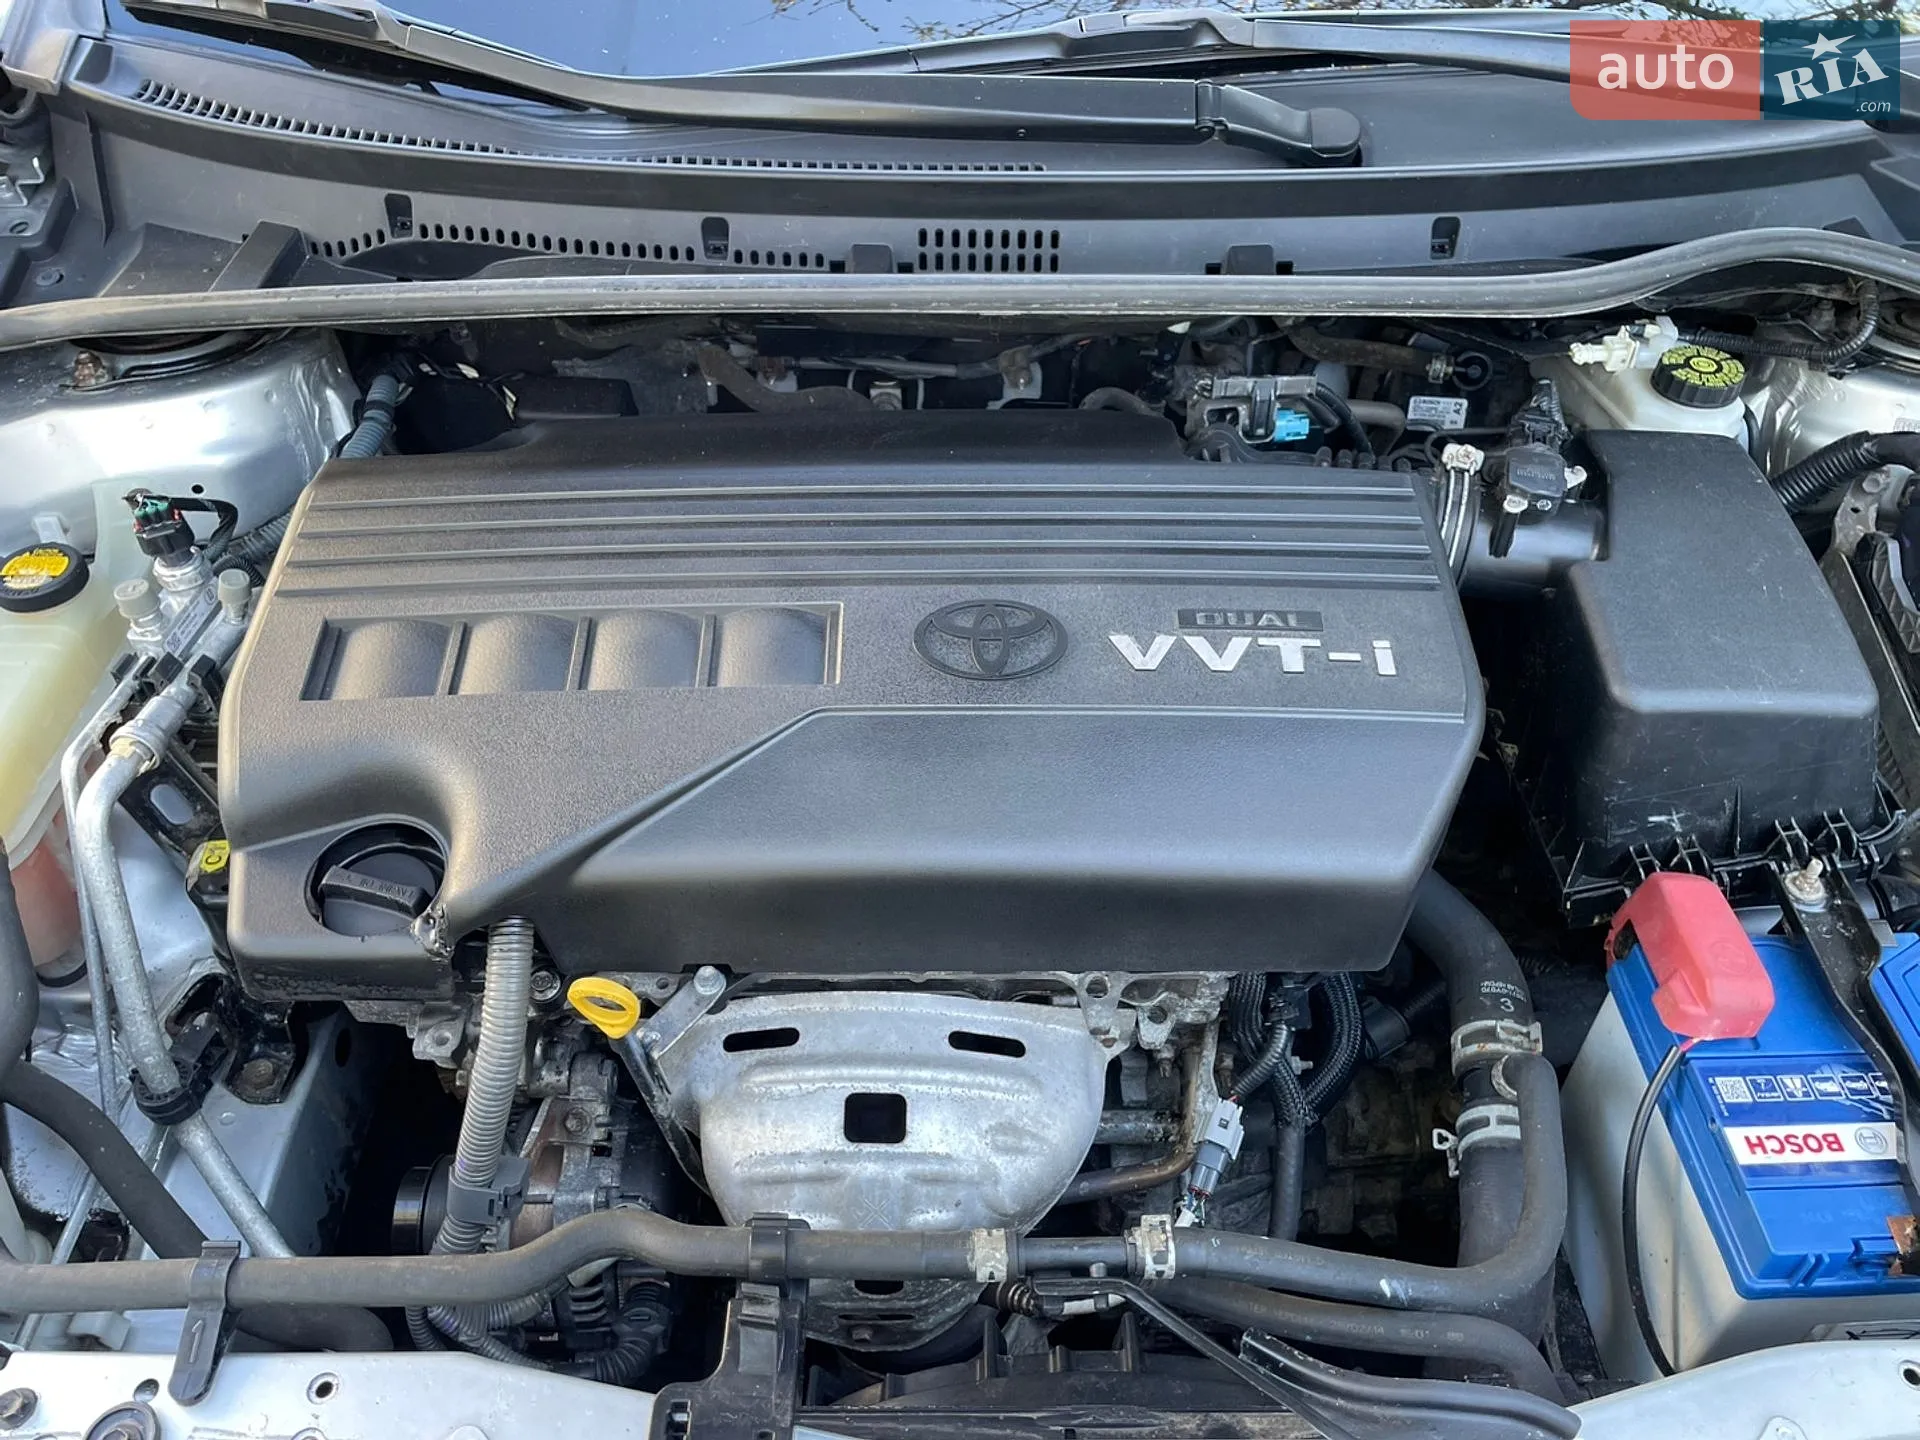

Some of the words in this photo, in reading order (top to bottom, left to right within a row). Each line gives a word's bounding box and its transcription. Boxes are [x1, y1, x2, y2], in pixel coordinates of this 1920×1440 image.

[1196, 611, 1304, 627] DUAL
[1500, 997, 1515, 1013] 3
[1743, 1132, 1845, 1155] BOSCH
